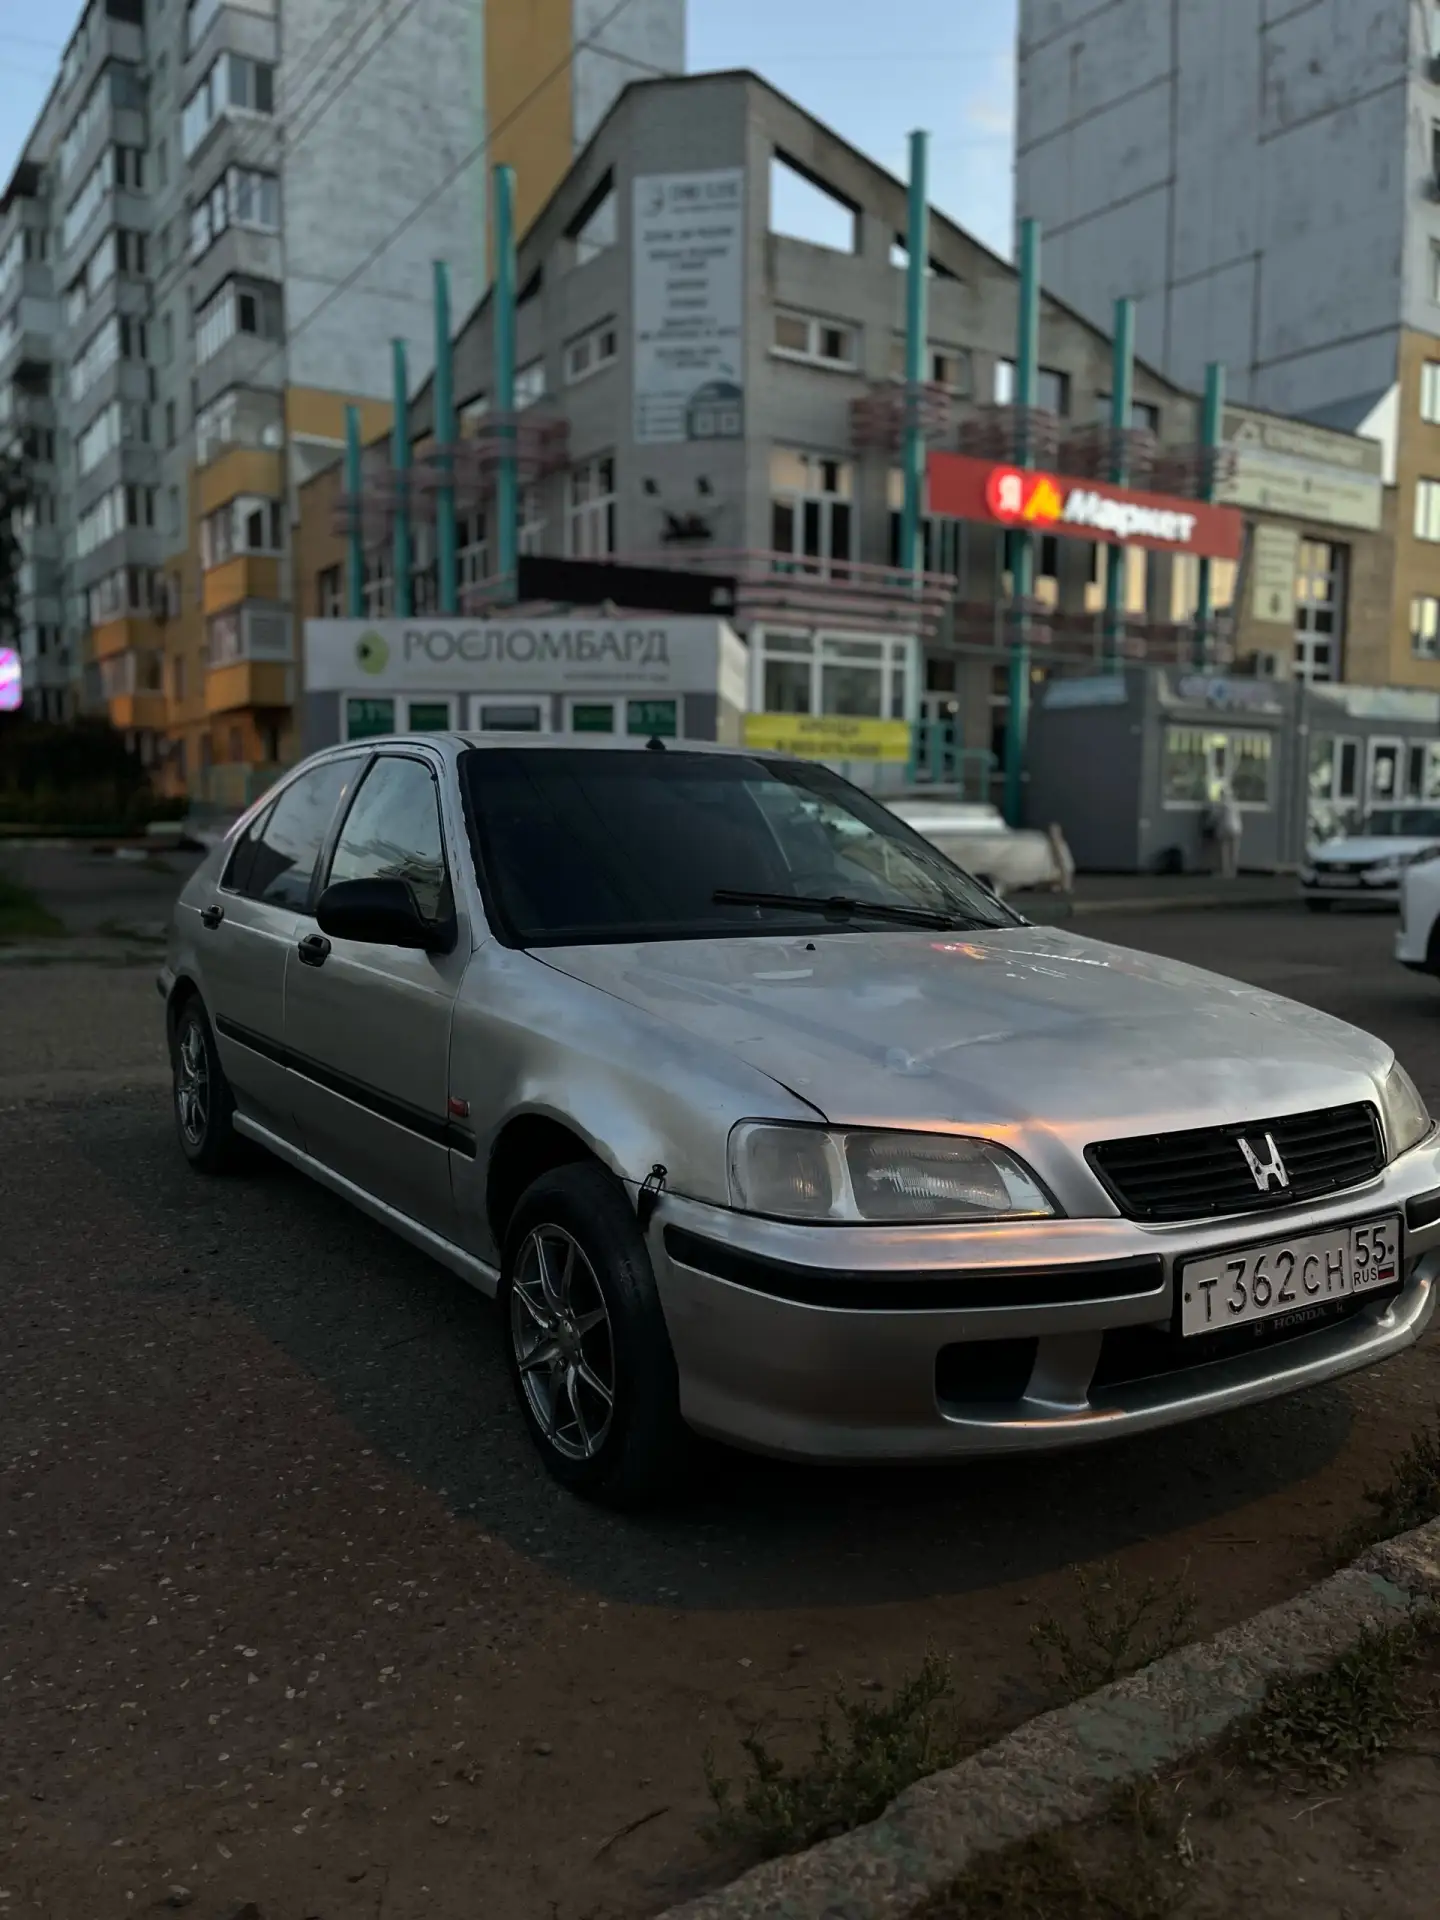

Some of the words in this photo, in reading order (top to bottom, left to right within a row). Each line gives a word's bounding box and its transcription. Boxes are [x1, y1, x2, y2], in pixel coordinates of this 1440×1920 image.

[1354, 1225, 1387, 1268] 55
[1353, 1266, 1378, 1286] RUS
[1273, 1306, 1328, 1331] HONDA
